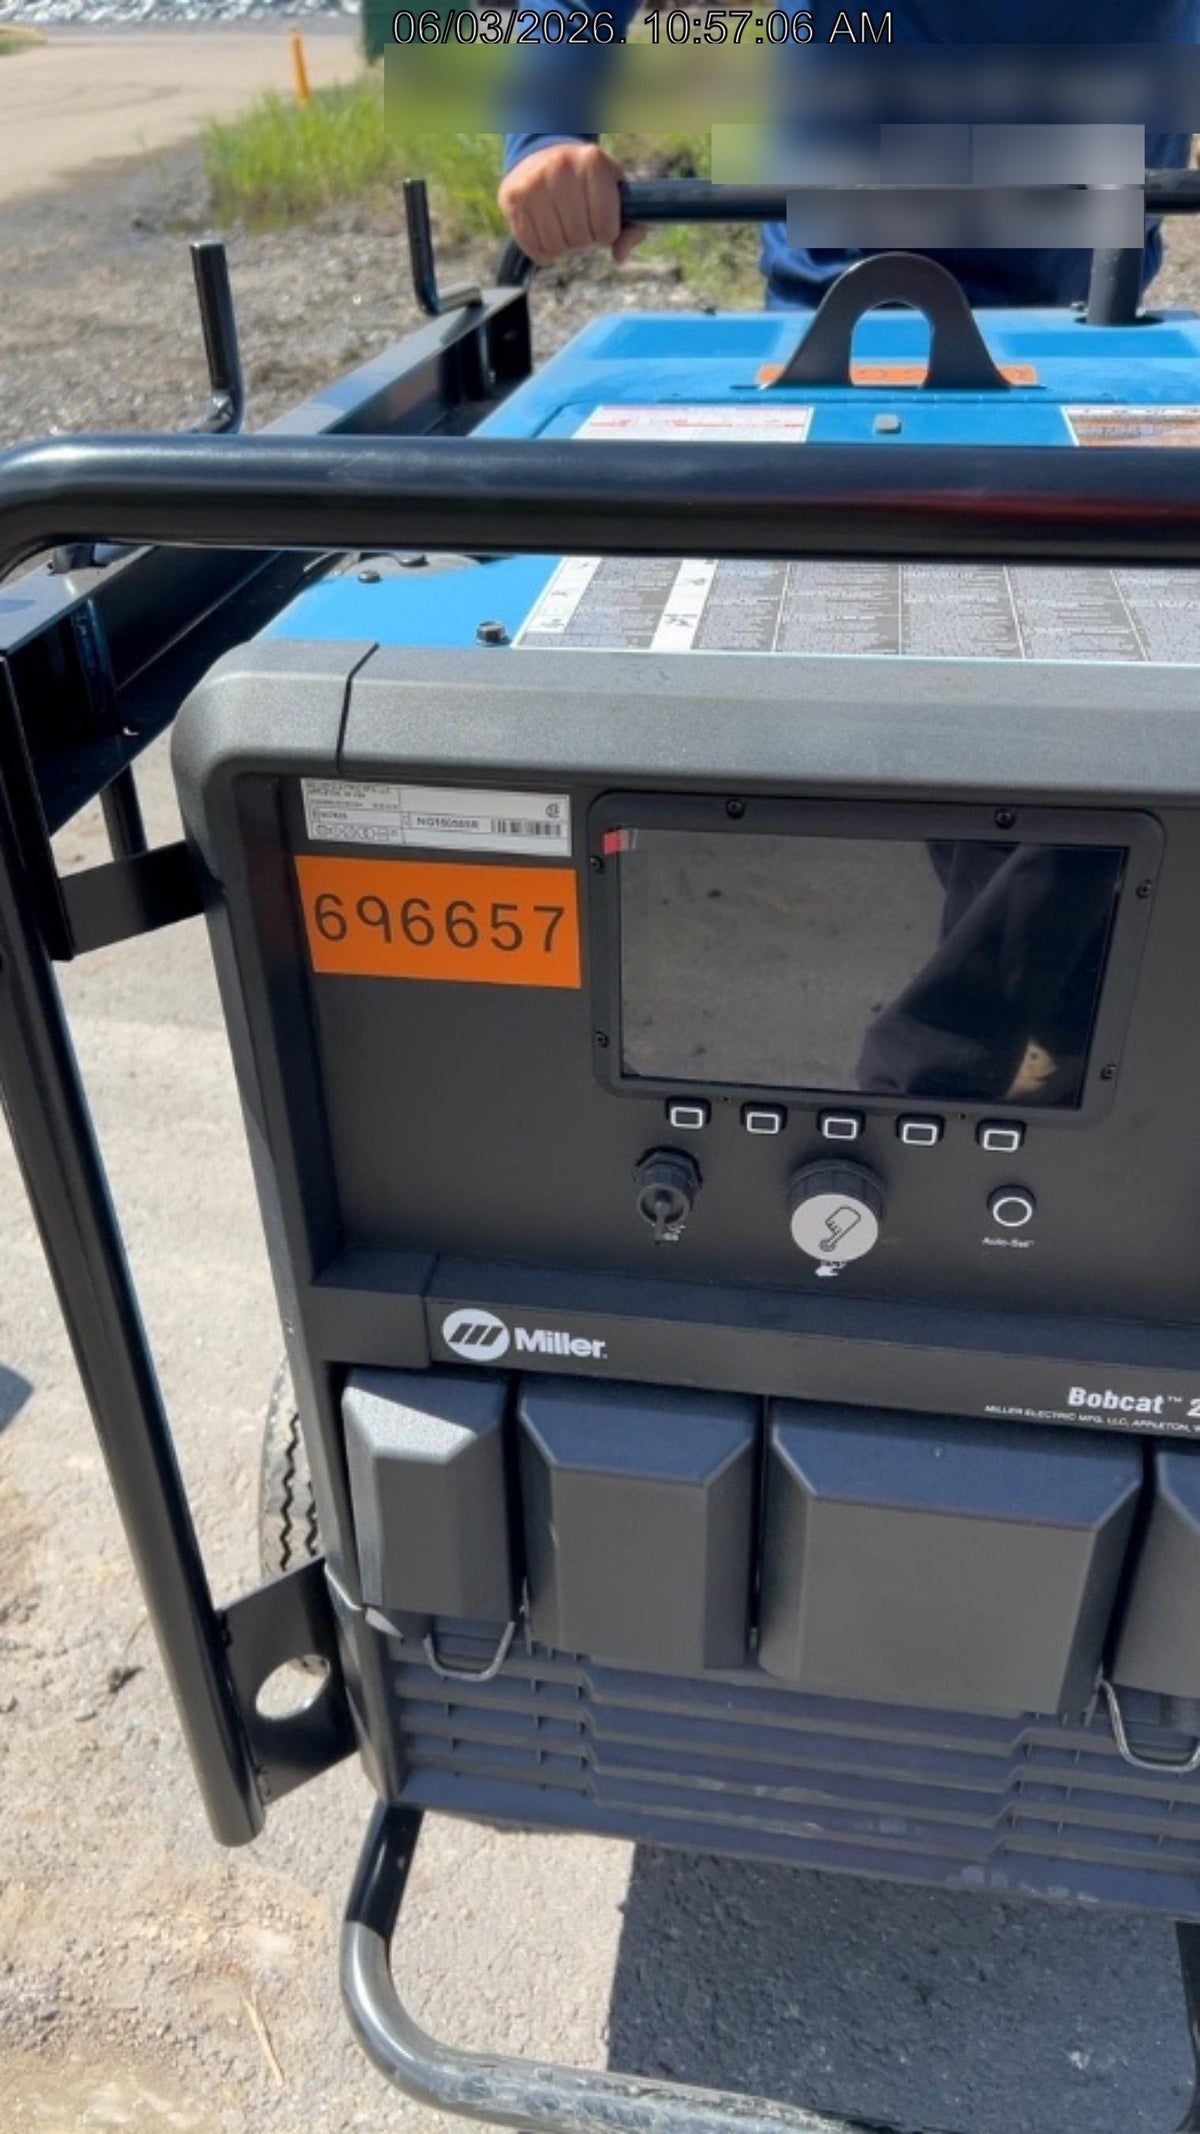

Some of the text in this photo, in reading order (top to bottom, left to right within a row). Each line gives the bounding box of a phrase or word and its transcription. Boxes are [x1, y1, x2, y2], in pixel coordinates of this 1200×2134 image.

[314, 893, 566, 953] 696657
[984, 1404, 1023, 1417] MILLER
[1024, 1408, 1076, 1421] ELECTRIC
